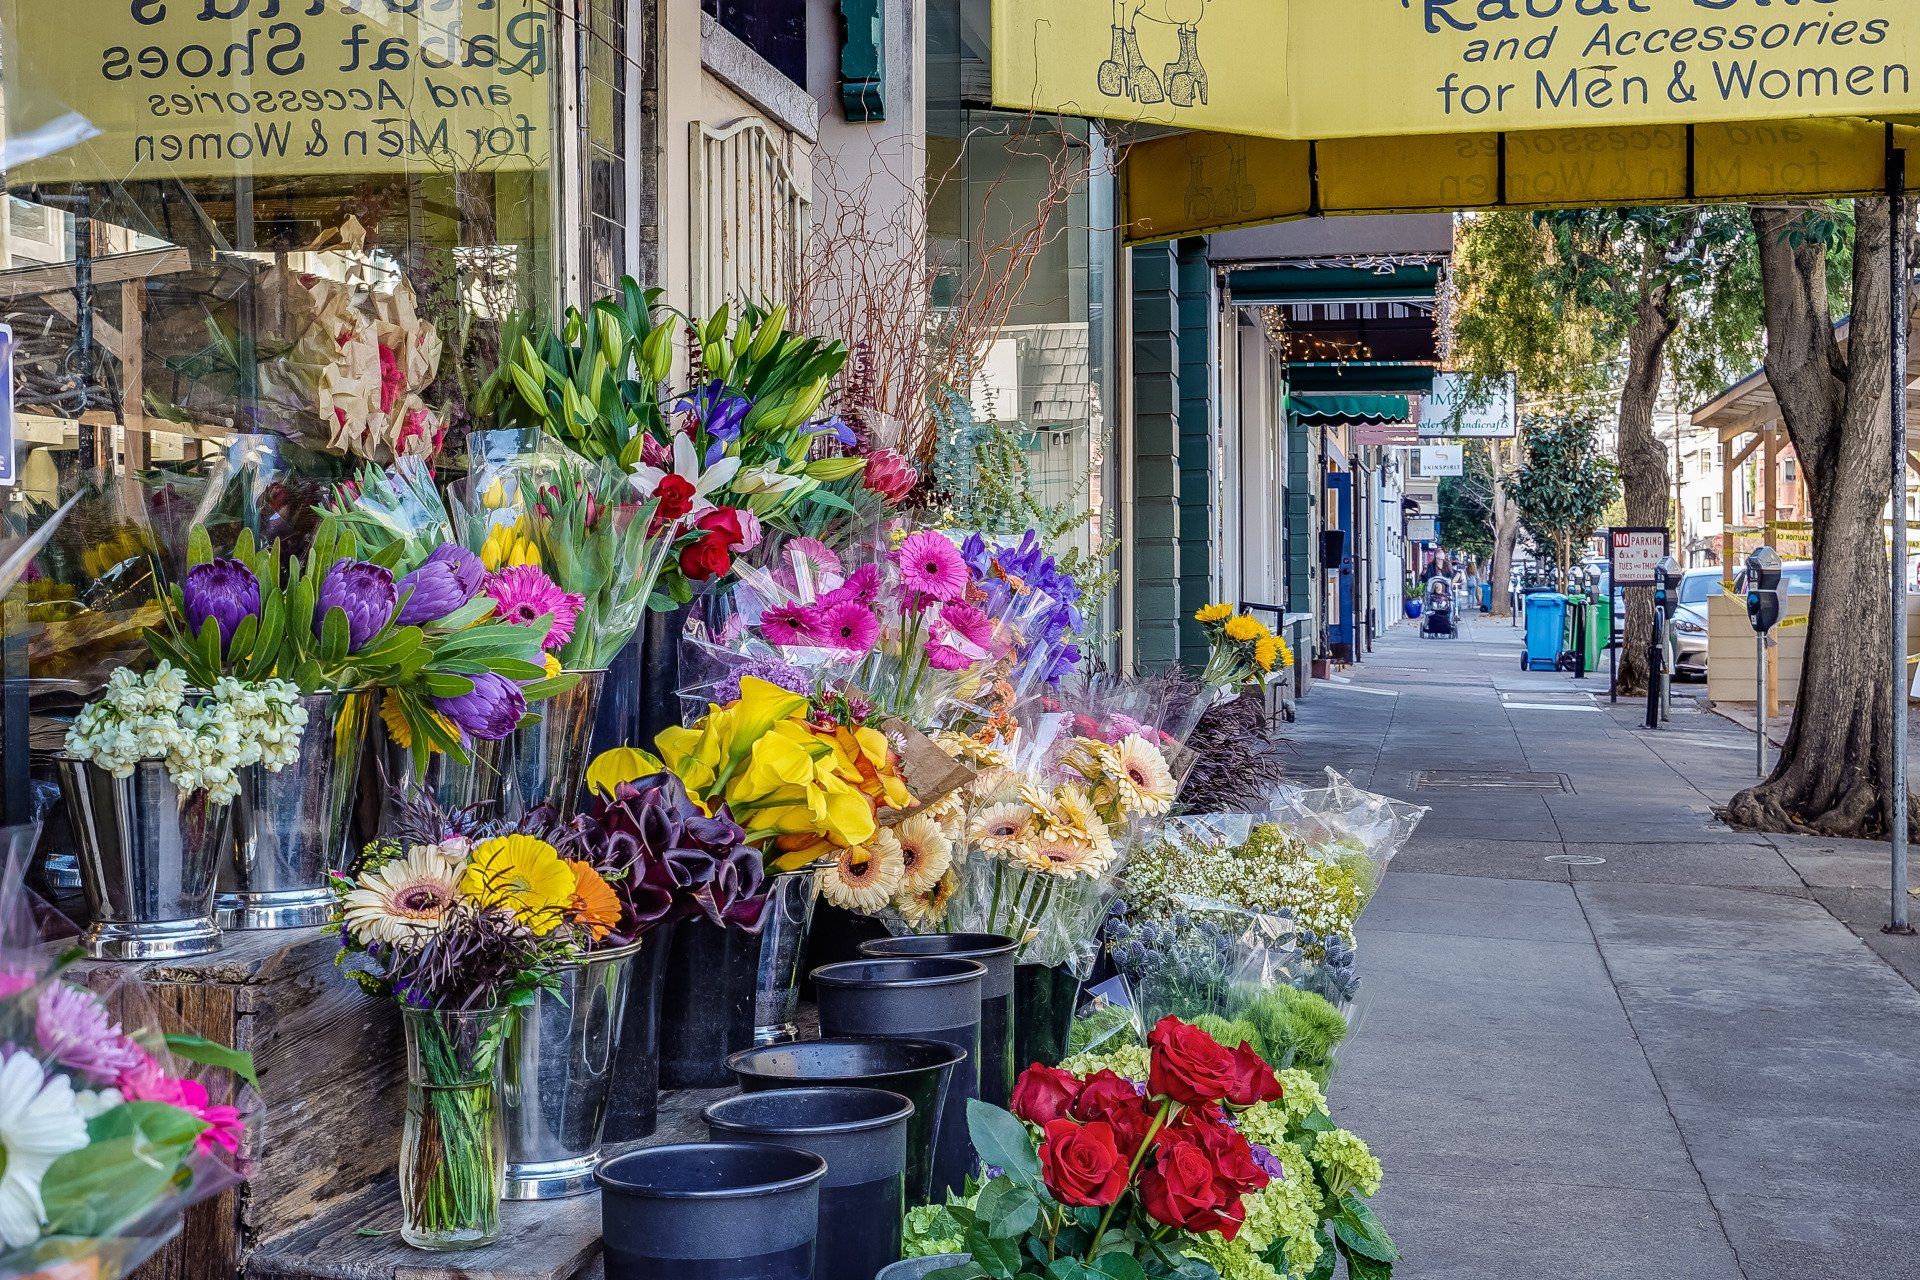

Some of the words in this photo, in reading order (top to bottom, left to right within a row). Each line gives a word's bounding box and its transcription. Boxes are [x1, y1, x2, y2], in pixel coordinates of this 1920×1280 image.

[1463, 25, 1559, 63] and
[1582, 11, 1890, 58] Accessories
[1436, 72, 1515, 115] for
[1667, 59, 1698, 104] &
[1712, 59, 1909, 101] Women
[1615, 534, 1629, 546] NO
[1631, 536, 1662, 546] PARKING
[1619, 549, 1625, 558] 6
[1643, 549, 1648, 558] 8
[1619, 562, 1633, 570] TUES
